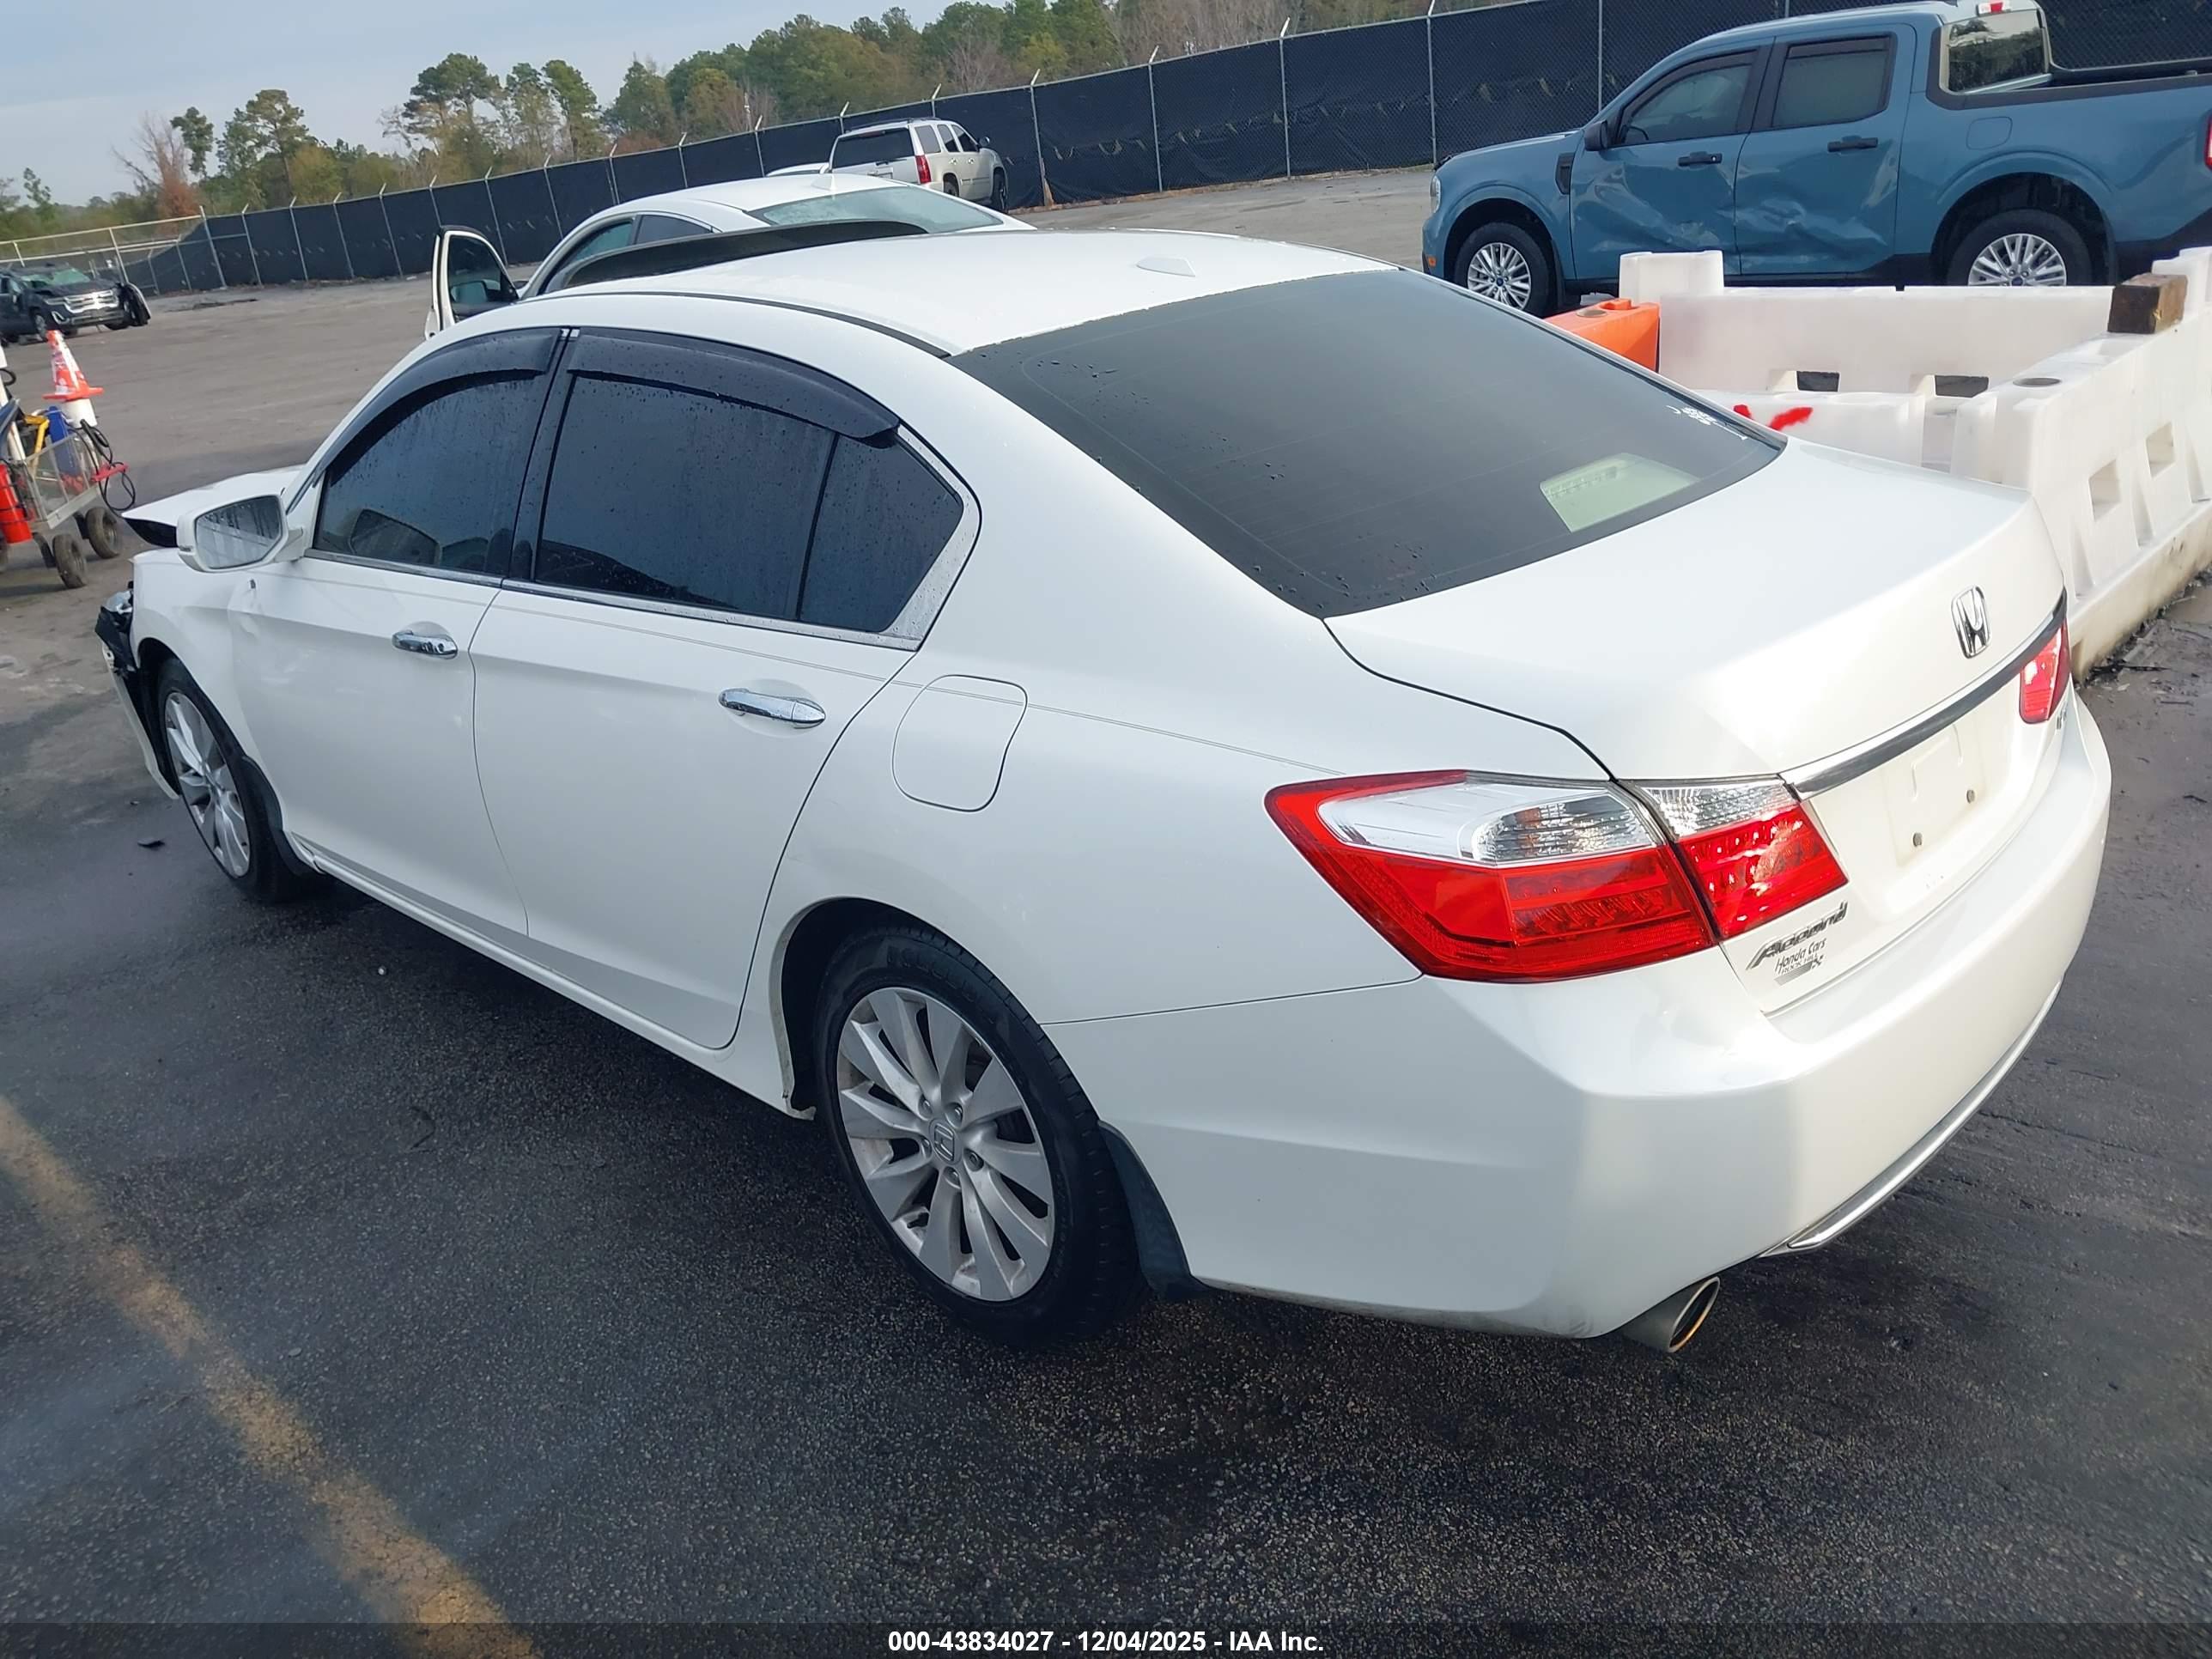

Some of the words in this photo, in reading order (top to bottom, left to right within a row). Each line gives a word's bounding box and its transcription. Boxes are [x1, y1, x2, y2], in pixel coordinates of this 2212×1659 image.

[1746, 902, 1848, 970] Accord
[1775, 948, 1808, 975] Honda
[1808, 937, 1827, 955] Cars
